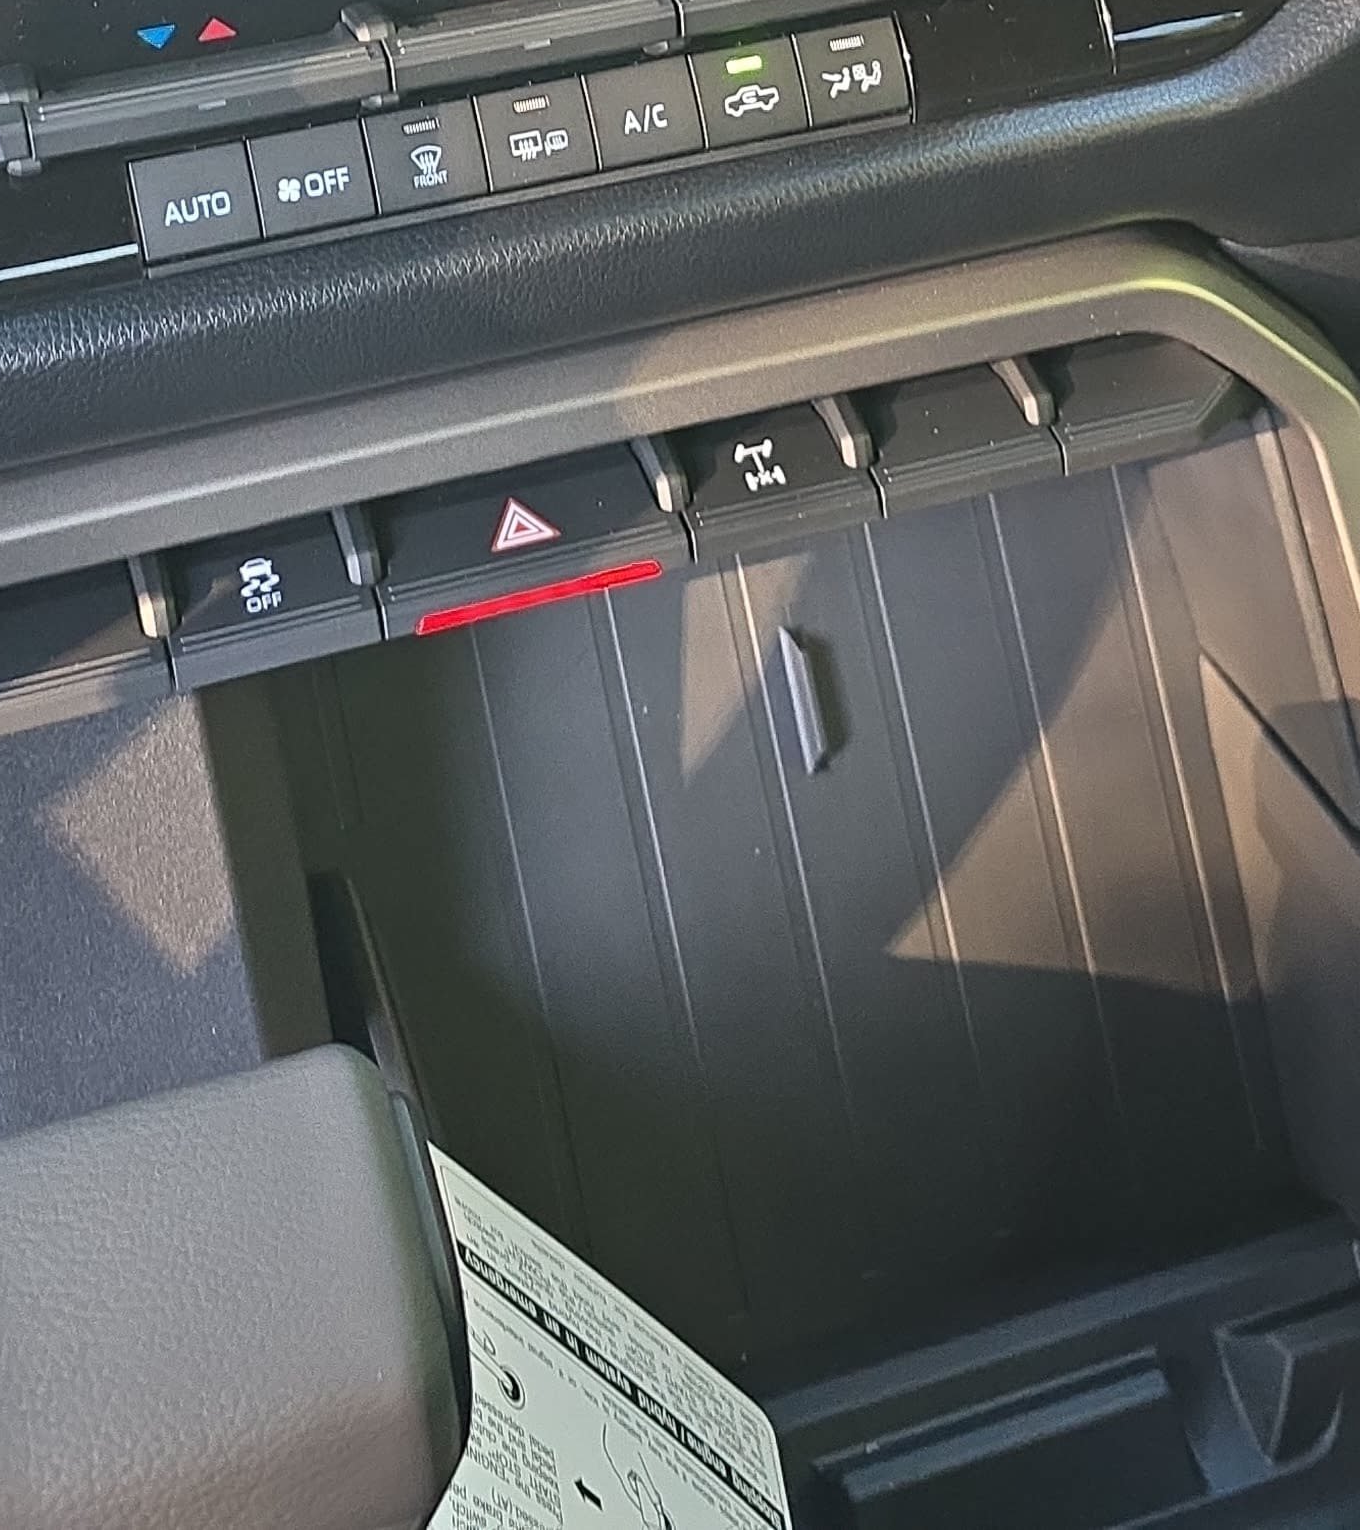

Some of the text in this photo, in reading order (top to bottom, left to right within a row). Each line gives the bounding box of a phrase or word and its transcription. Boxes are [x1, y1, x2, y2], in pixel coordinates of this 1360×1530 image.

[623, 103, 669, 135] A/C
[303, 166, 352, 199] OFF
[413, 170, 448, 189] FRONT
[163, 190, 233, 227] AUTO
[246, 590, 282, 614] OFF
[465, 1248, 538, 1319] emergency
[543, 1310, 561, 1337] an
[565, 1327, 581, 1357] in
